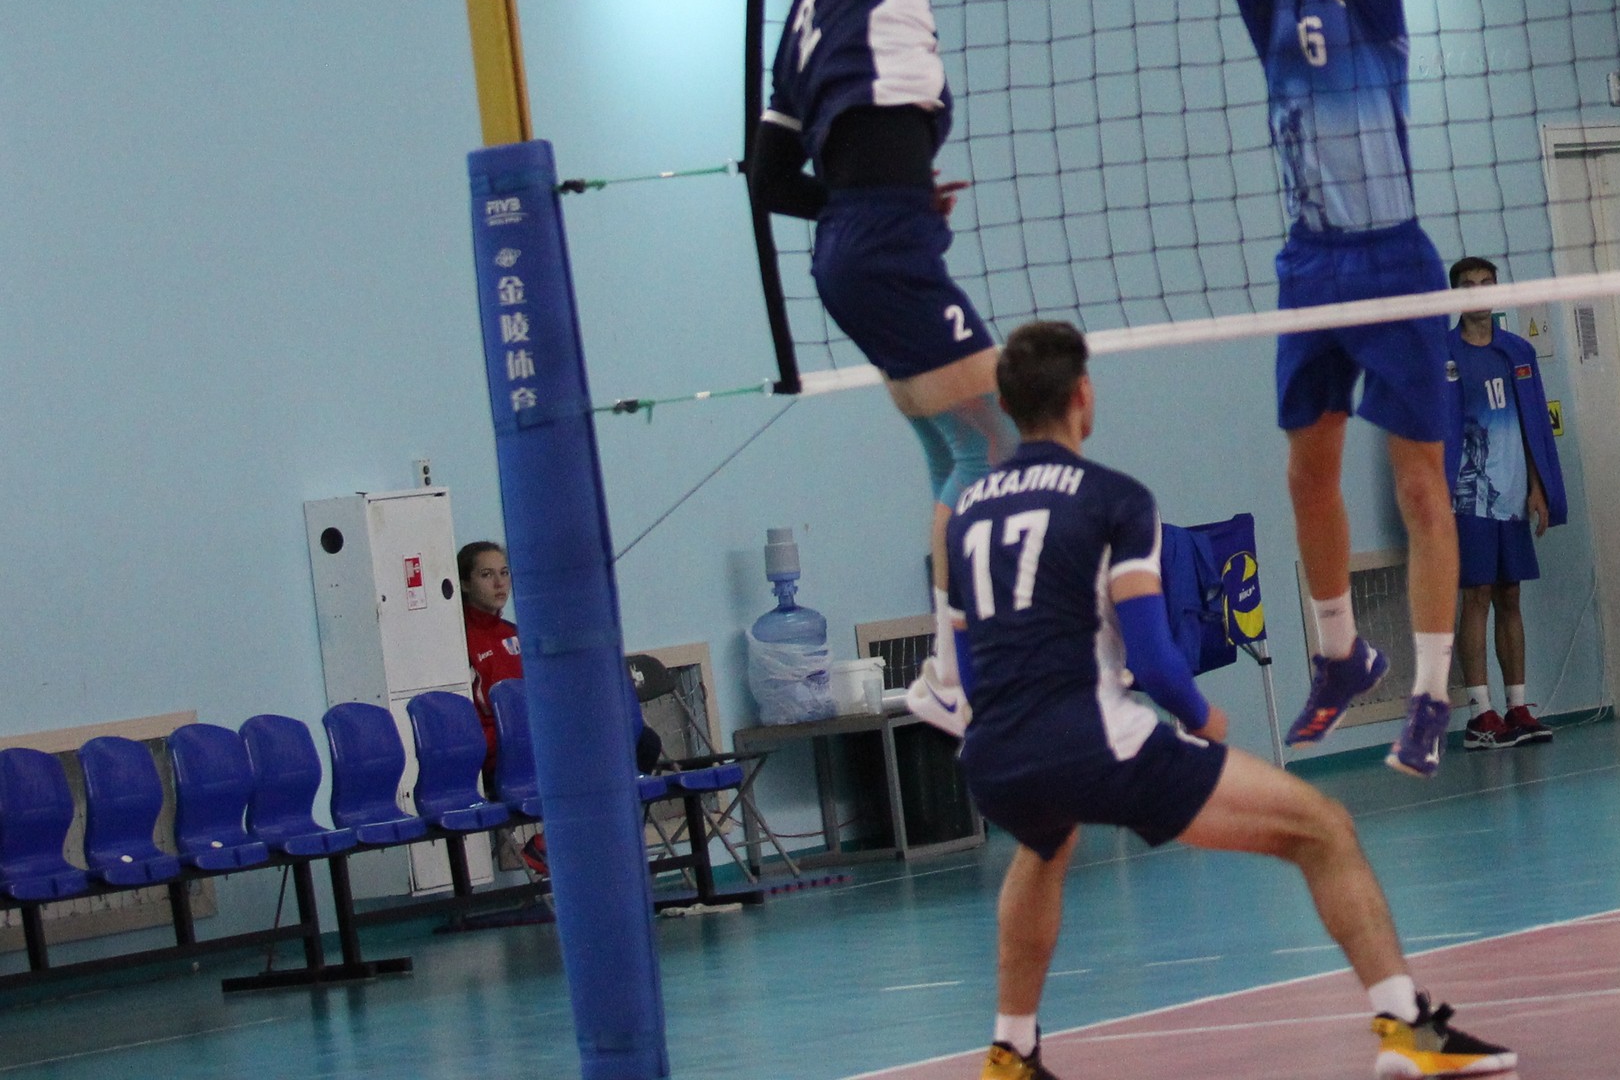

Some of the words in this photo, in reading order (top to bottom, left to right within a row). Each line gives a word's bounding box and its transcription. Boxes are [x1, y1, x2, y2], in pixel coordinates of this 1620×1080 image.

[1297, 15, 1327, 67] 6
[944, 304, 974, 342] 2
[1484, 377, 1507, 410] 10
[955, 463, 1086, 517] САХАЛИН
[963, 508, 1051, 621] 17
